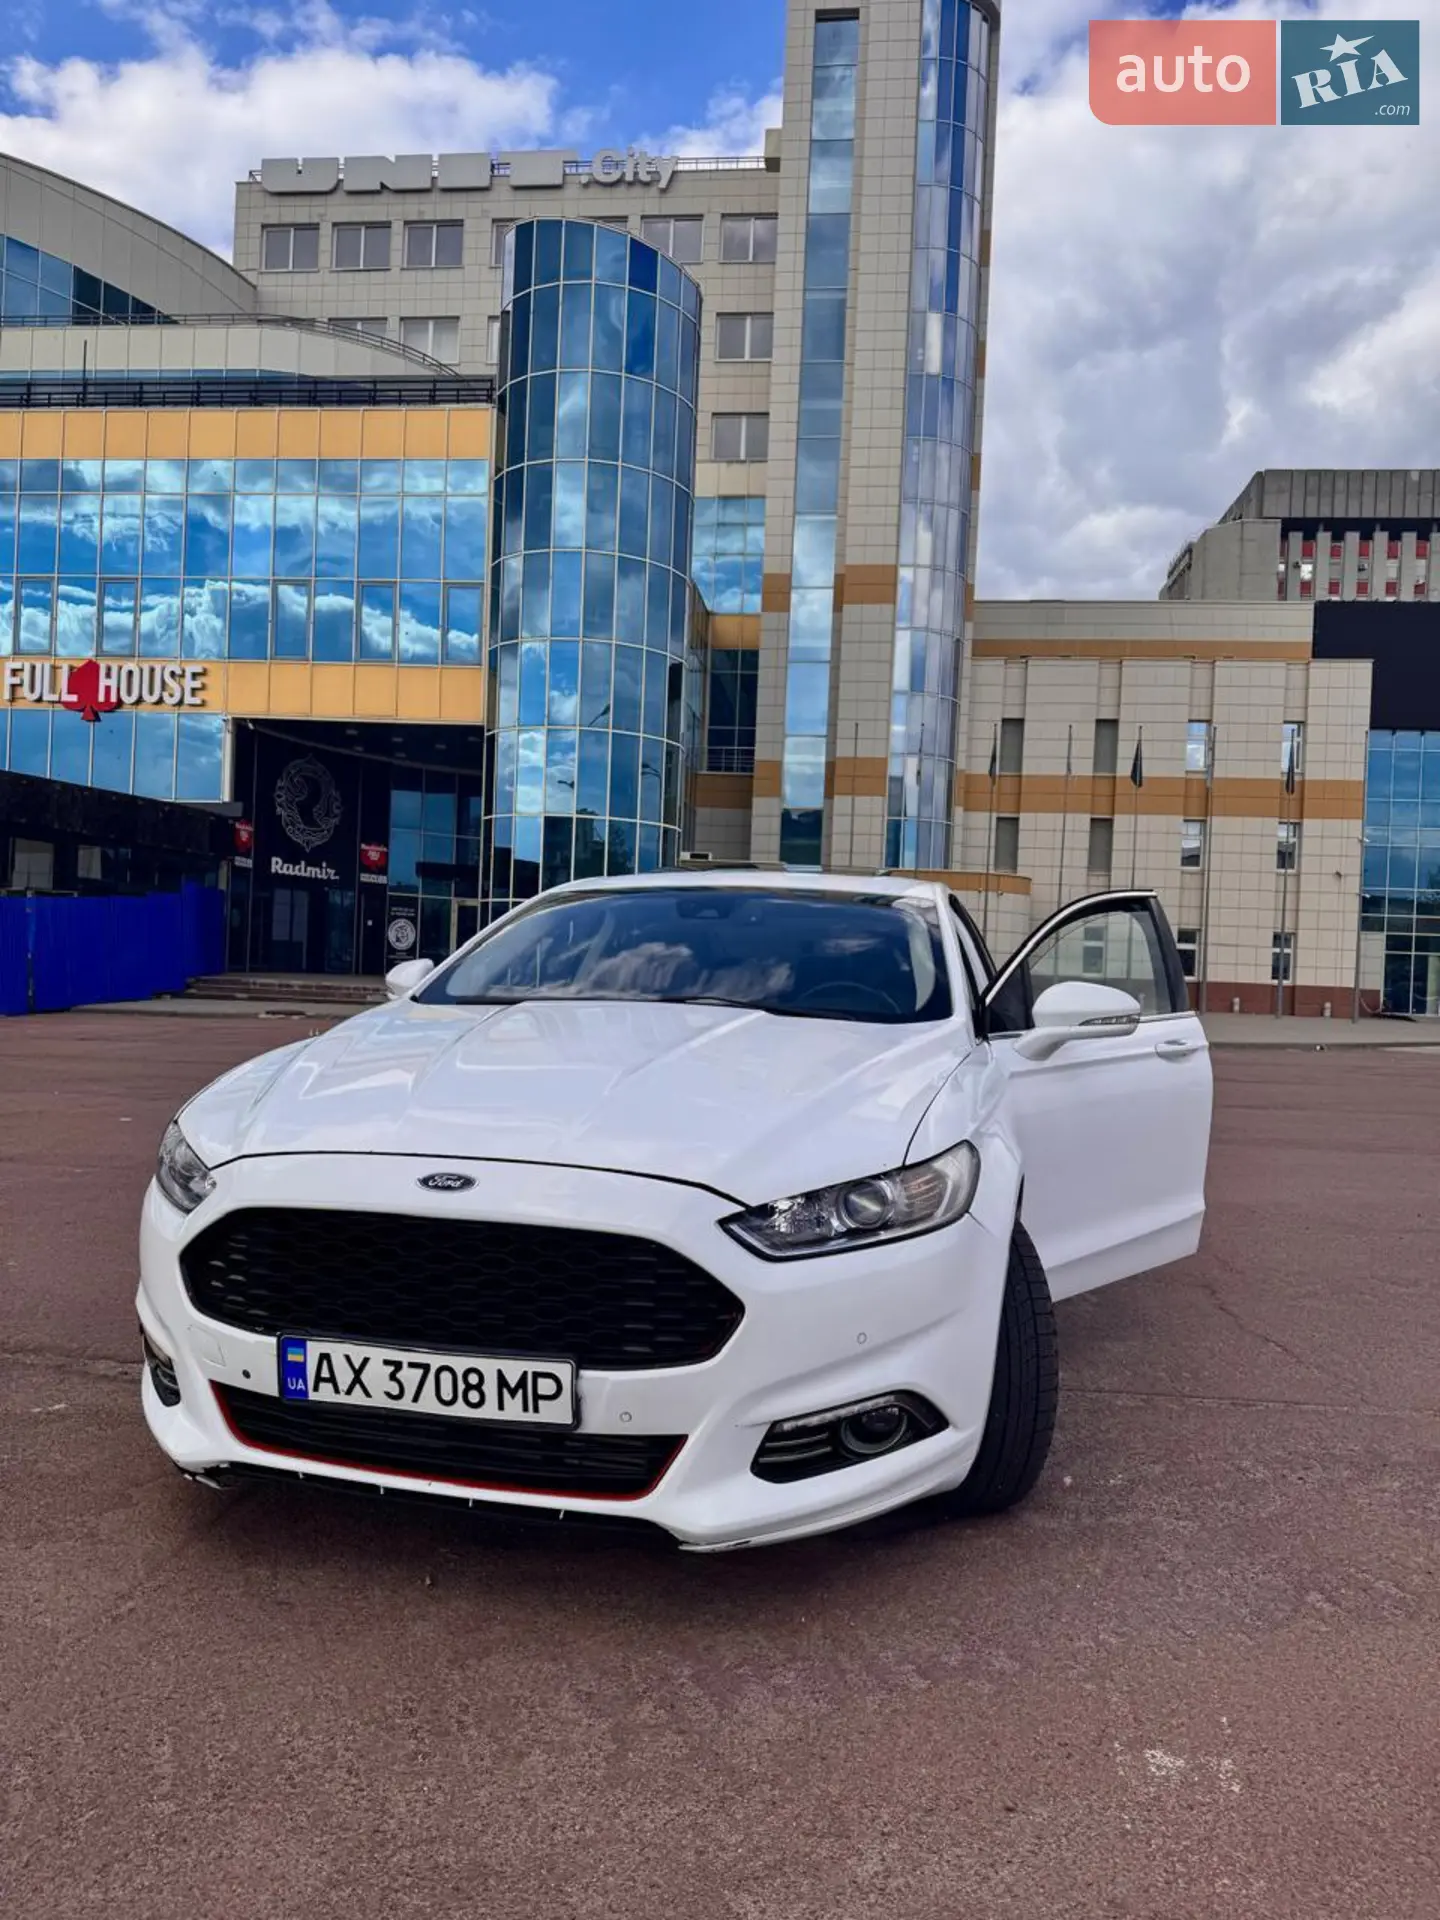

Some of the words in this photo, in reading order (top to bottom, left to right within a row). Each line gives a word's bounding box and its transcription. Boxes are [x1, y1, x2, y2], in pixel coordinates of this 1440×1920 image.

[3, 661, 79, 702] FULL
[98, 663, 205, 706] HOUSE
[270, 856, 340, 880] Radmir
[428, 1175, 465, 1188] Ford
[287, 1377, 306, 1392] UA
[312, 1352, 373, 1399] AX
[382, 1358, 486, 1410] 3708
[497, 1368, 564, 1414] MP
